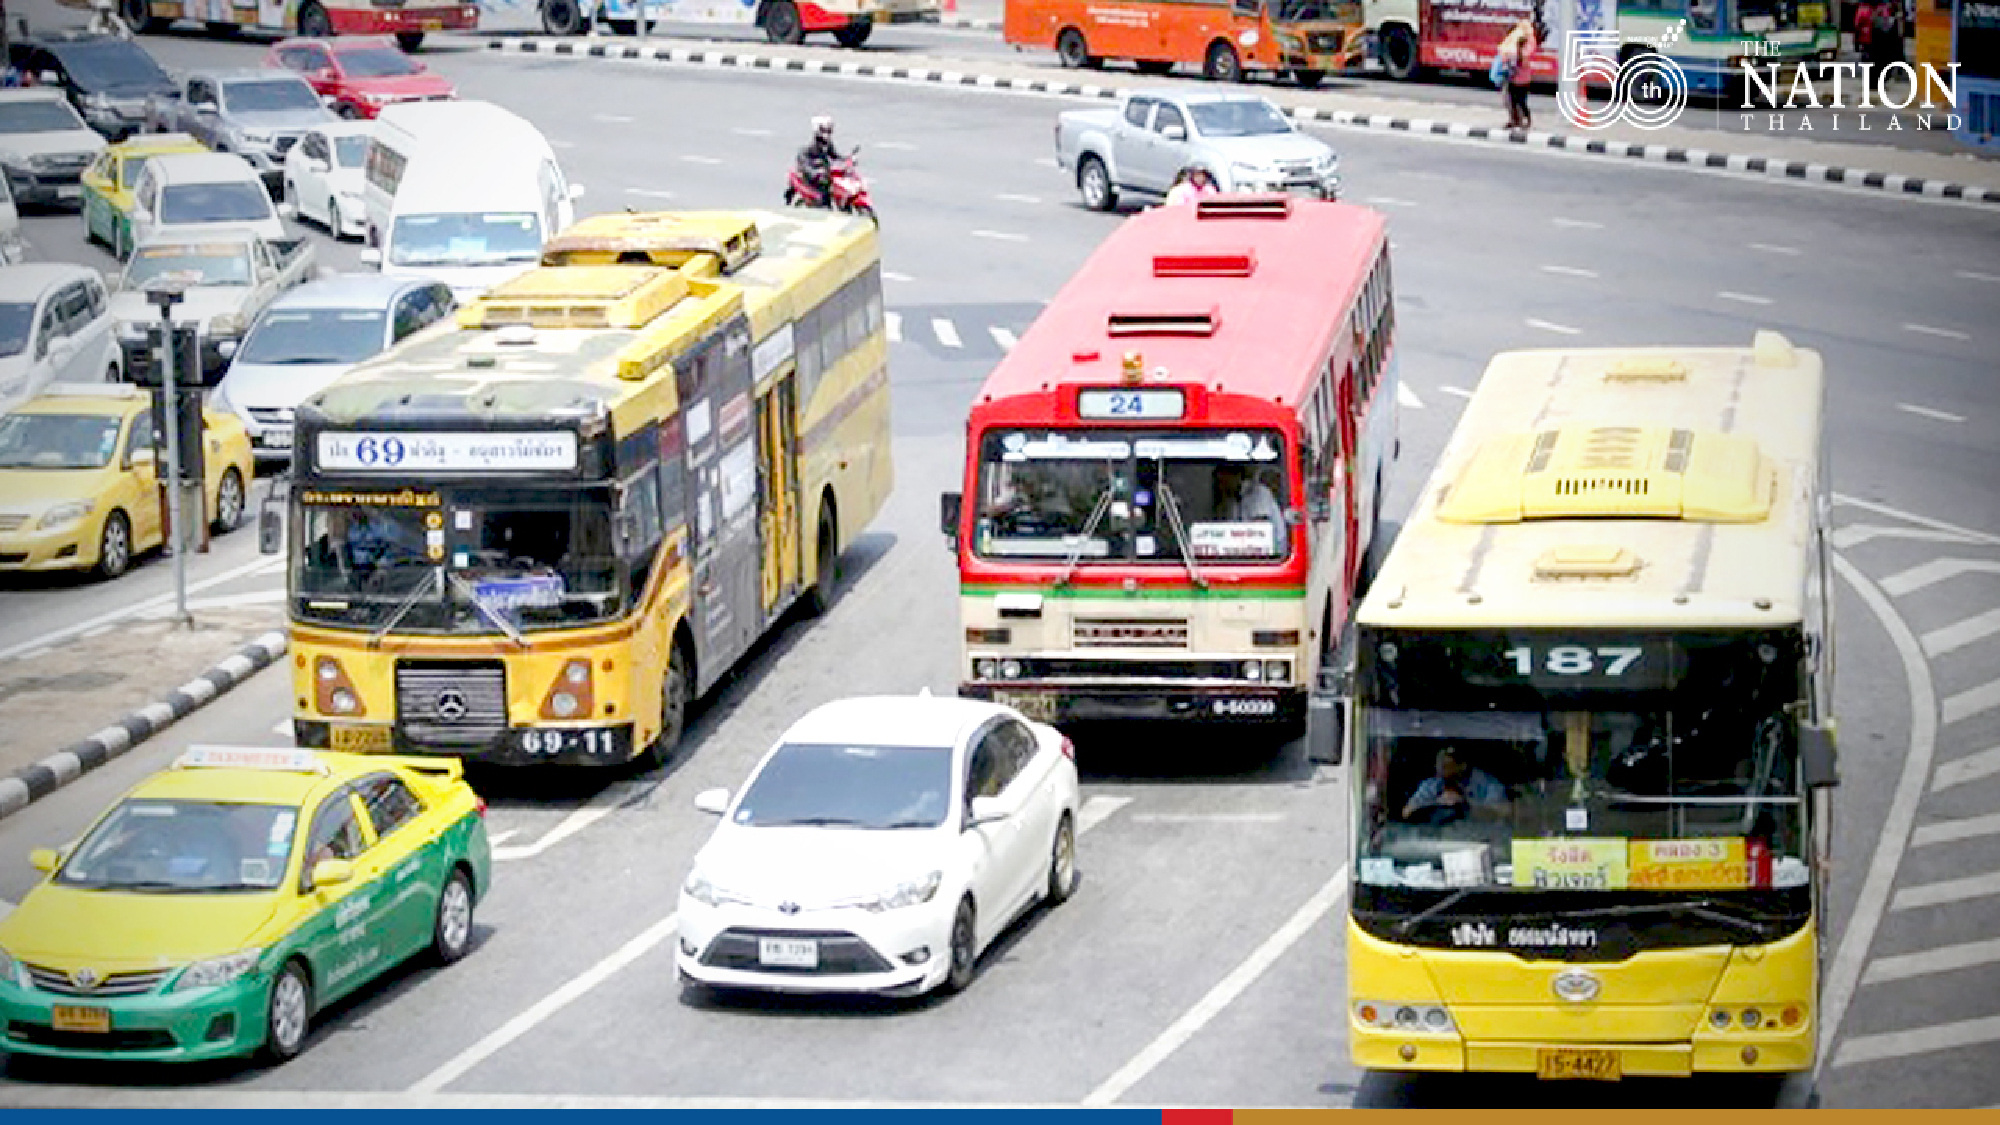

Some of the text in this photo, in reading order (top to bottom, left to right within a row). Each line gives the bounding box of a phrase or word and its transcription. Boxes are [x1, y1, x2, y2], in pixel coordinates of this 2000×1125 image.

[1109, 395, 1143, 415] 24
[356, 436, 405, 467] 69
[1503, 646, 1643, 676] 187
[521, 730, 614, 754] 69-11
